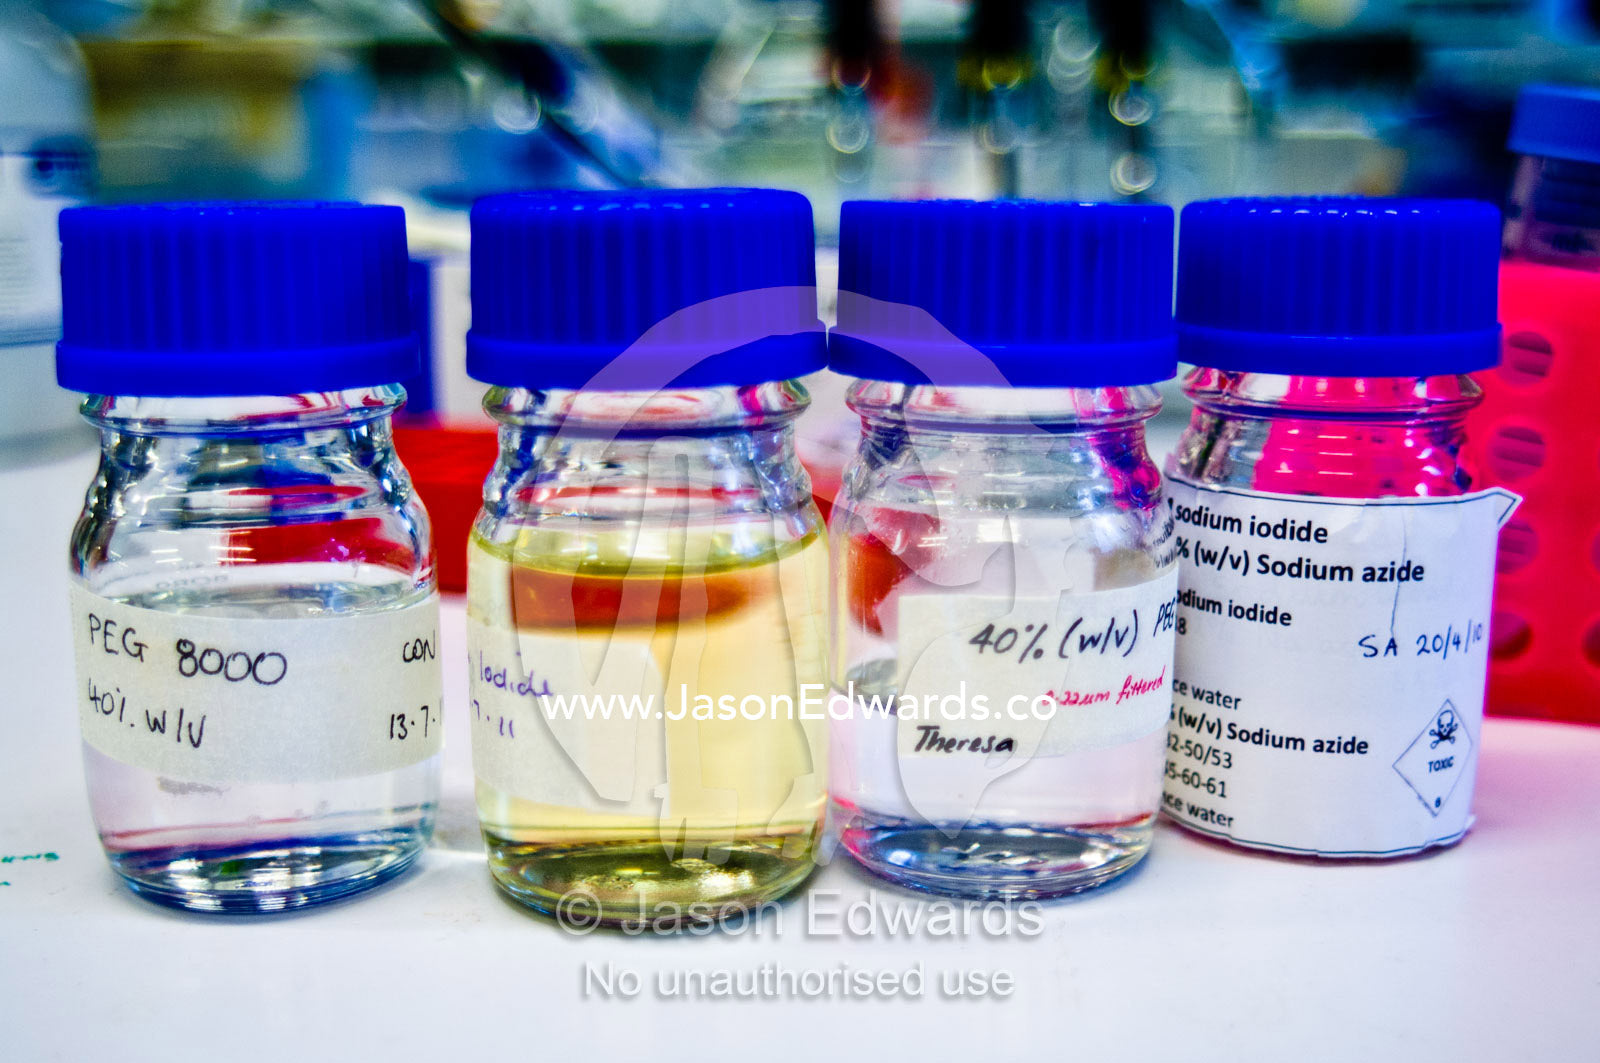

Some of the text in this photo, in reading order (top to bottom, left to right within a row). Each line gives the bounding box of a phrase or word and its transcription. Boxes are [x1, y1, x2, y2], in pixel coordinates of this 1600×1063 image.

[1174, 504, 1242, 534] sodium
[1249, 515, 1328, 543] iodide
[1194, 540, 1250, 576] (w/v)
[1256, 554, 1353, 582] Sodium
[1362, 560, 1425, 583] azide
[1228, 599, 1292, 626] iodide
[88, 613, 149, 662] PEG
[176, 638, 287, 685] 8000
[967, 624, 1049, 664] 40%
[1058, 609, 1139, 658] (w/v)
[1358, 634, 1398, 658] SA
[1191, 685, 1242, 710] water
[914, 725, 1015, 752] Theresa
[1179, 706, 1222, 740] (w/v)
[1226, 722, 1305, 751] Sodium
[1313, 736, 1369, 755] azide
[1428, 756, 1454, 773] TOXIC
[1187, 802, 1234, 828] water
